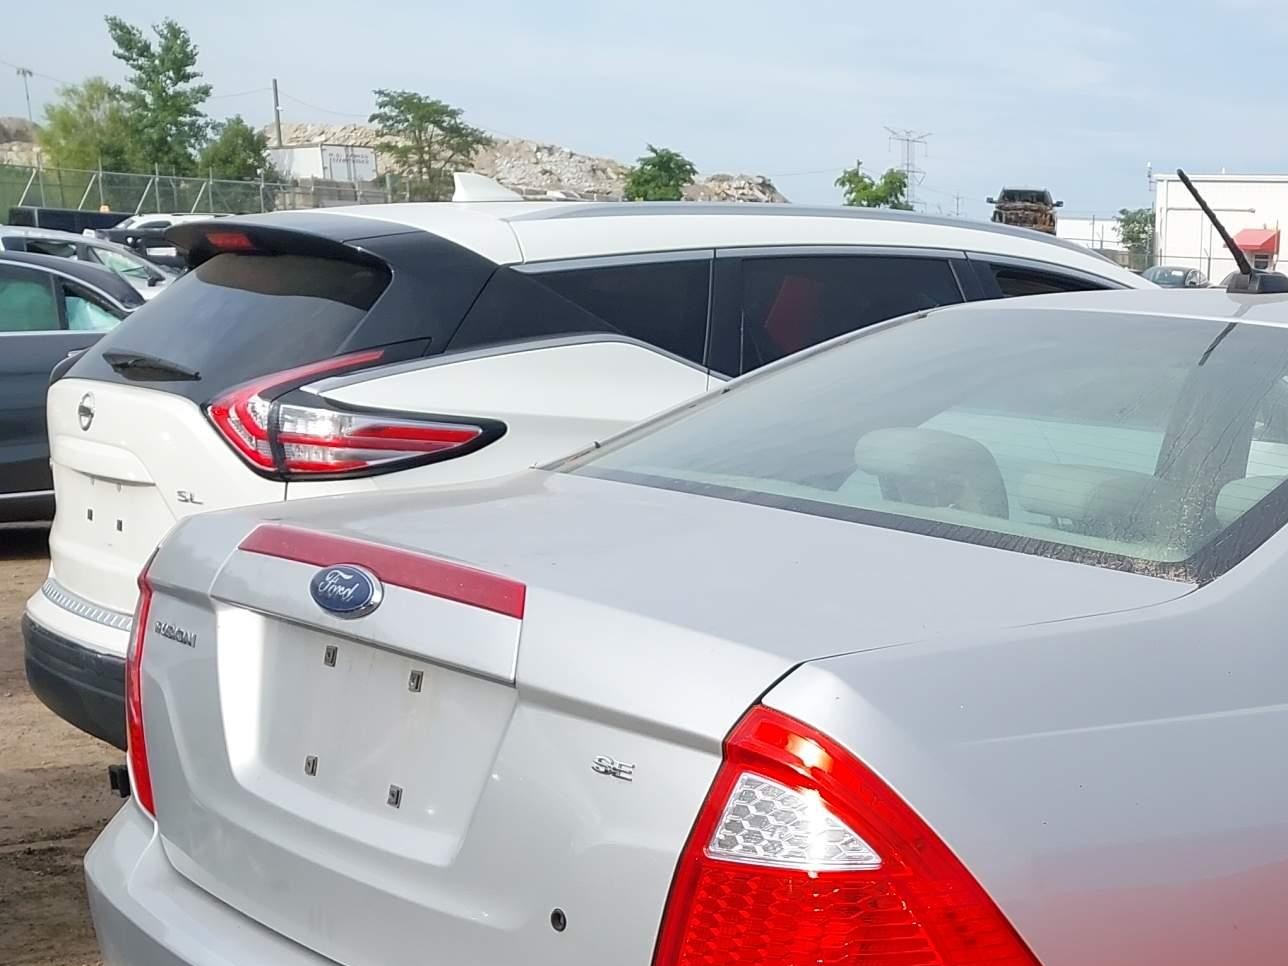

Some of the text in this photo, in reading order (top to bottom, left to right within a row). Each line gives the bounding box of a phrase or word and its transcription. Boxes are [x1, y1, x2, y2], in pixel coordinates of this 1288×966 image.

[176, 489, 204, 505] SL
[318, 569, 360, 602] Ford
[591, 755, 635, 782] SE
